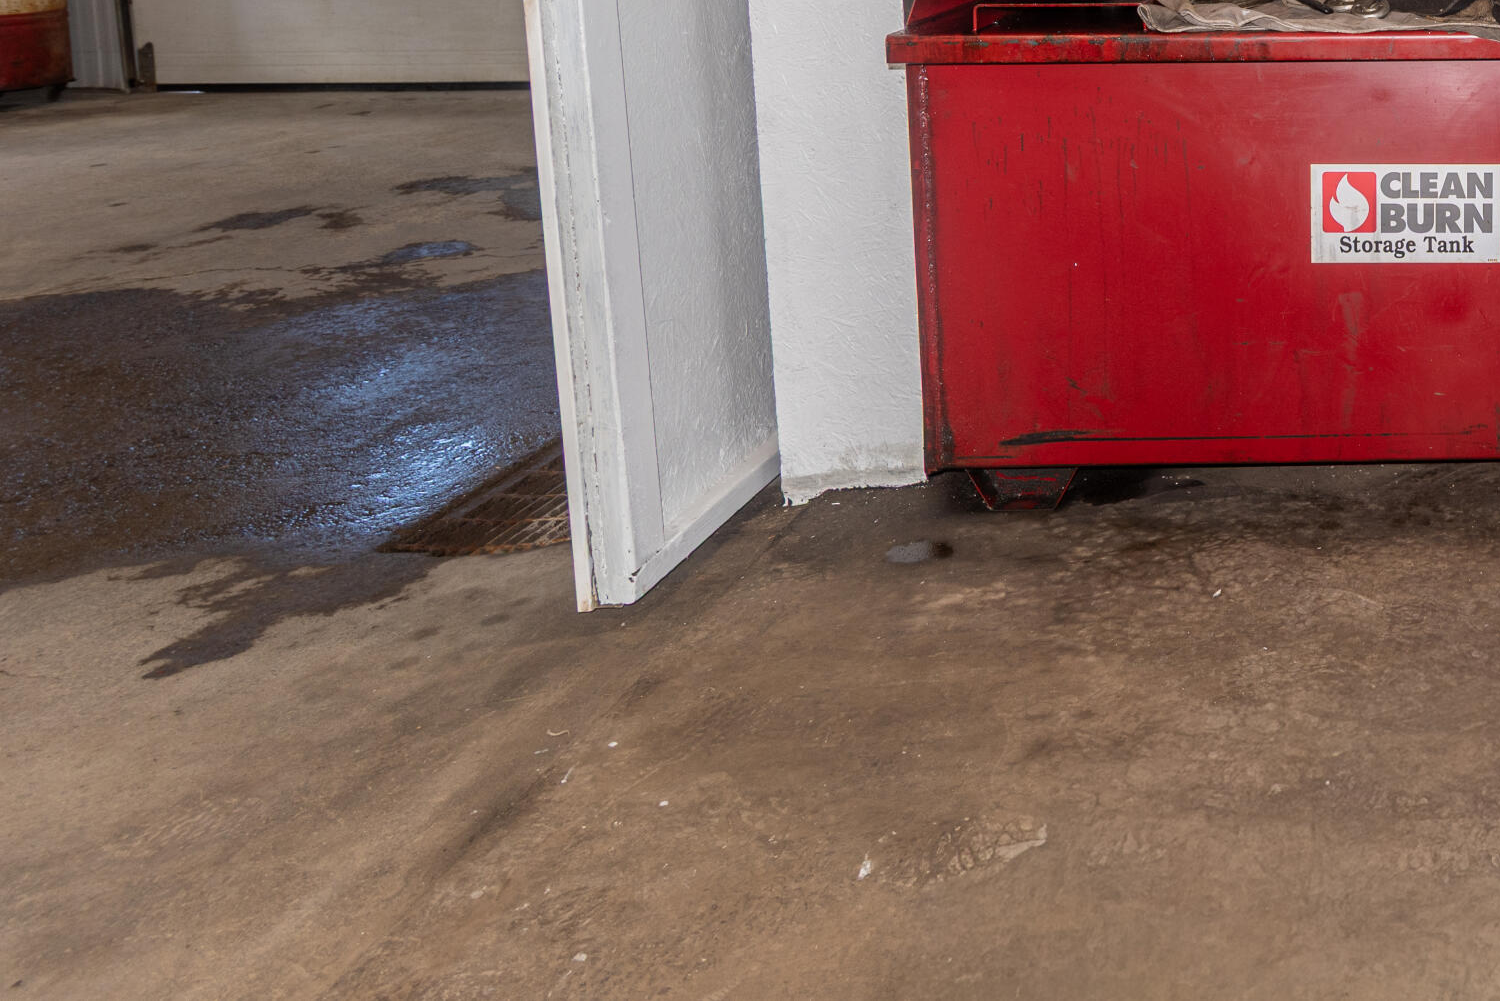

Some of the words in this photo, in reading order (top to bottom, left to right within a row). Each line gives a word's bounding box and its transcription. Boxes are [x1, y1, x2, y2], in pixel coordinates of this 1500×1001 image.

[1380, 171, 1494, 199] CLEAN
[1380, 202, 1494, 234] BURN
[1339, 235, 1416, 259] Storage
[1423, 235, 1475, 254] Tank
